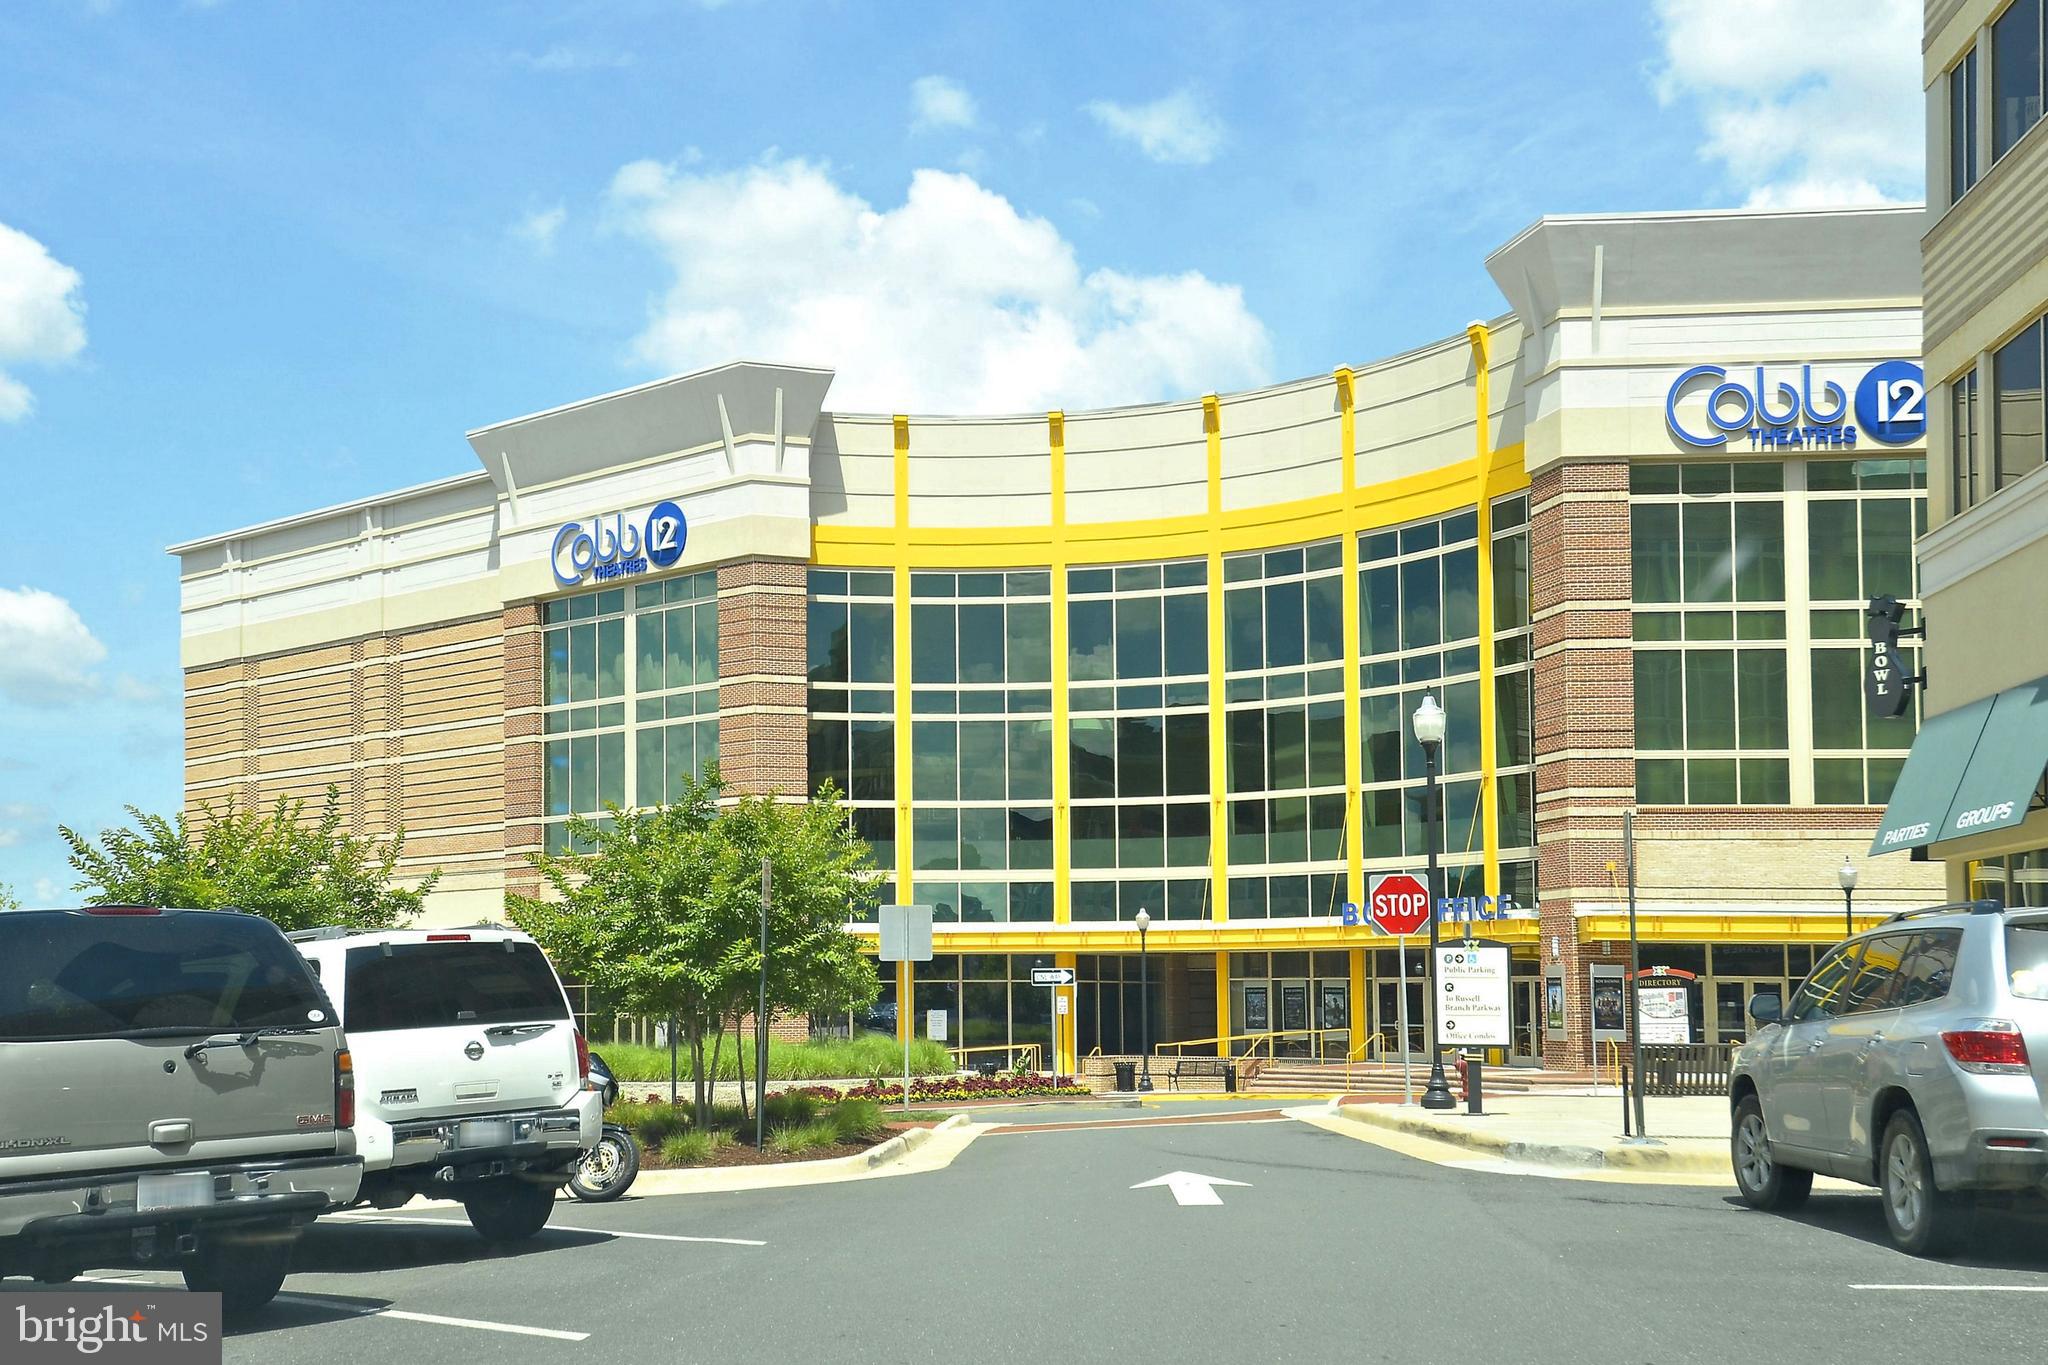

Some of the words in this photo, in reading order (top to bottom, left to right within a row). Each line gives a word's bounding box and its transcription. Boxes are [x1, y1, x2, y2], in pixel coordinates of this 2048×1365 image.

[1666, 363, 1847, 447] Cobb
[1877, 379, 1925, 423] 12
[1748, 425, 1857, 447] THEATRES
[551, 512, 641, 585] Cobb
[651, 515, 678, 552] 12
[593, 556, 648, 580] THEATRES
[1873, 641, 1891, 695] BOWL
[1956, 801, 2015, 829] GROUPS
[1882, 822, 1931, 845] PARTIES
[1375, 893, 1426, 917] STOP
[1437, 894, 1511, 922] FFICE
[1468, 966, 1496, 975] Parking
[1639, 978, 1681, 987] DIRECTORY
[296, 1113, 333, 1126] GMC
